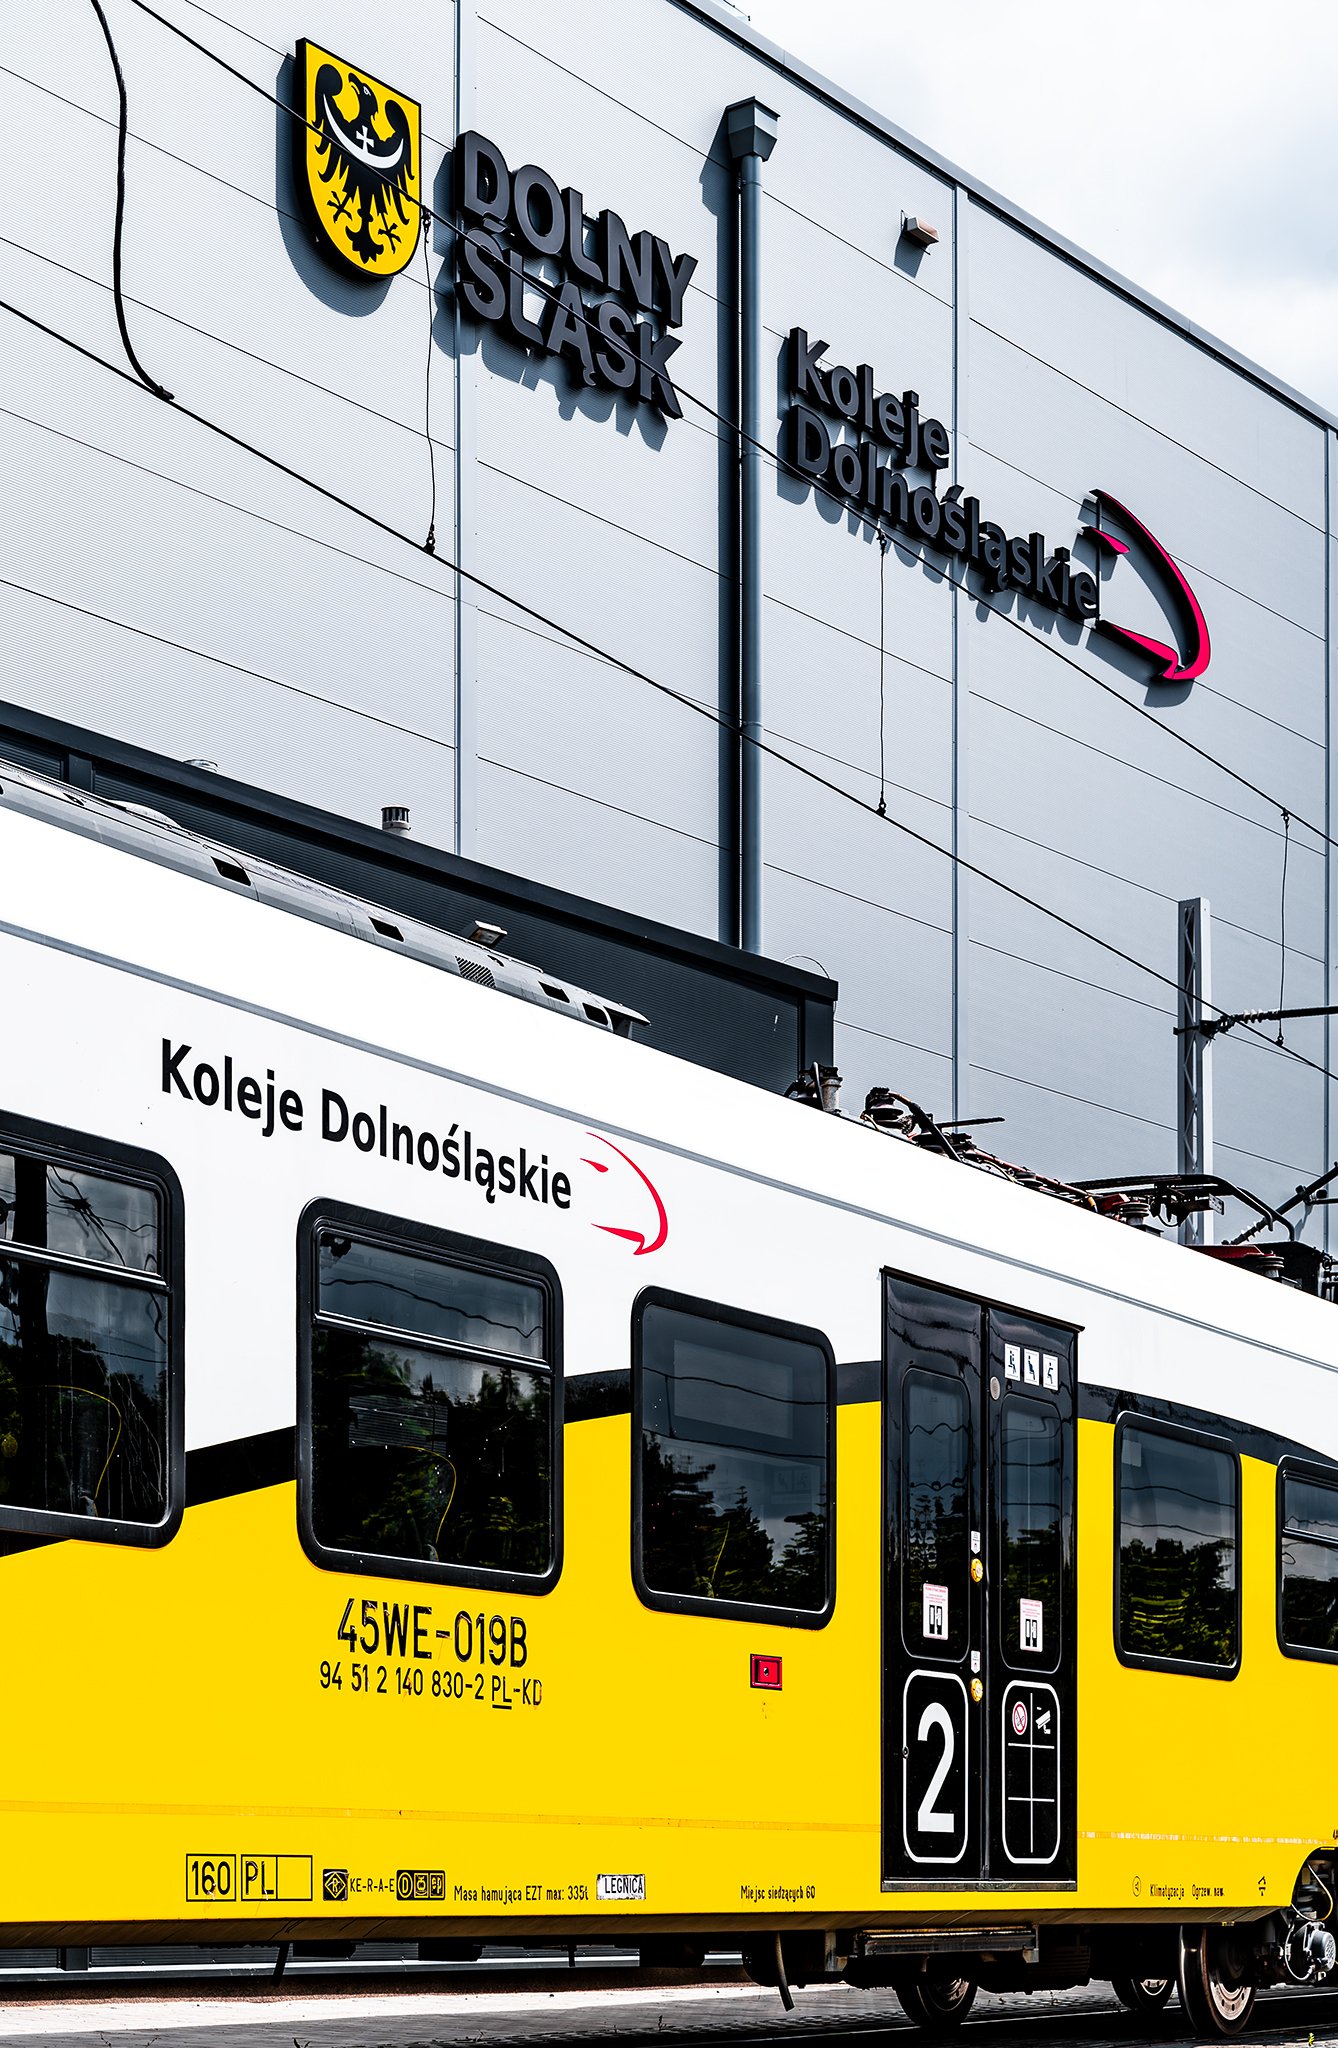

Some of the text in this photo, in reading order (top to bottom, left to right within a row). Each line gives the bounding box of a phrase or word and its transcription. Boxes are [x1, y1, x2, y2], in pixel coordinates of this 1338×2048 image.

[457, 130, 698, 328] DOLNY
[456, 221, 683, 419] ŚLĄSK
[790, 327, 949, 469] Koleje
[791, 405, 1099, 618] Dolnośląskie
[161, 1038, 572, 1209] Koleje Dolnośląskie
[337, 1598, 528, 1668] 45WE-019B
[319, 1661, 543, 1709] 94 51 2 140 830-2 PL-KD
[917, 1702, 955, 1833] 2
[191, 1860, 231, 1895] 160
[245, 1860, 275, 1895] PL
[350, 1878, 395, 1892] KE-R-A-E
[454, 1885, 478, 1901] Masa
[481, 1885, 522, 1905] hamująca
[525, 1885, 542, 1901] EZT
[546, 1885, 564, 1901] max:
[605, 1876, 644, 1895] LEGNICA
[740, 1885, 815, 1903] Miejsc siedzących 60
